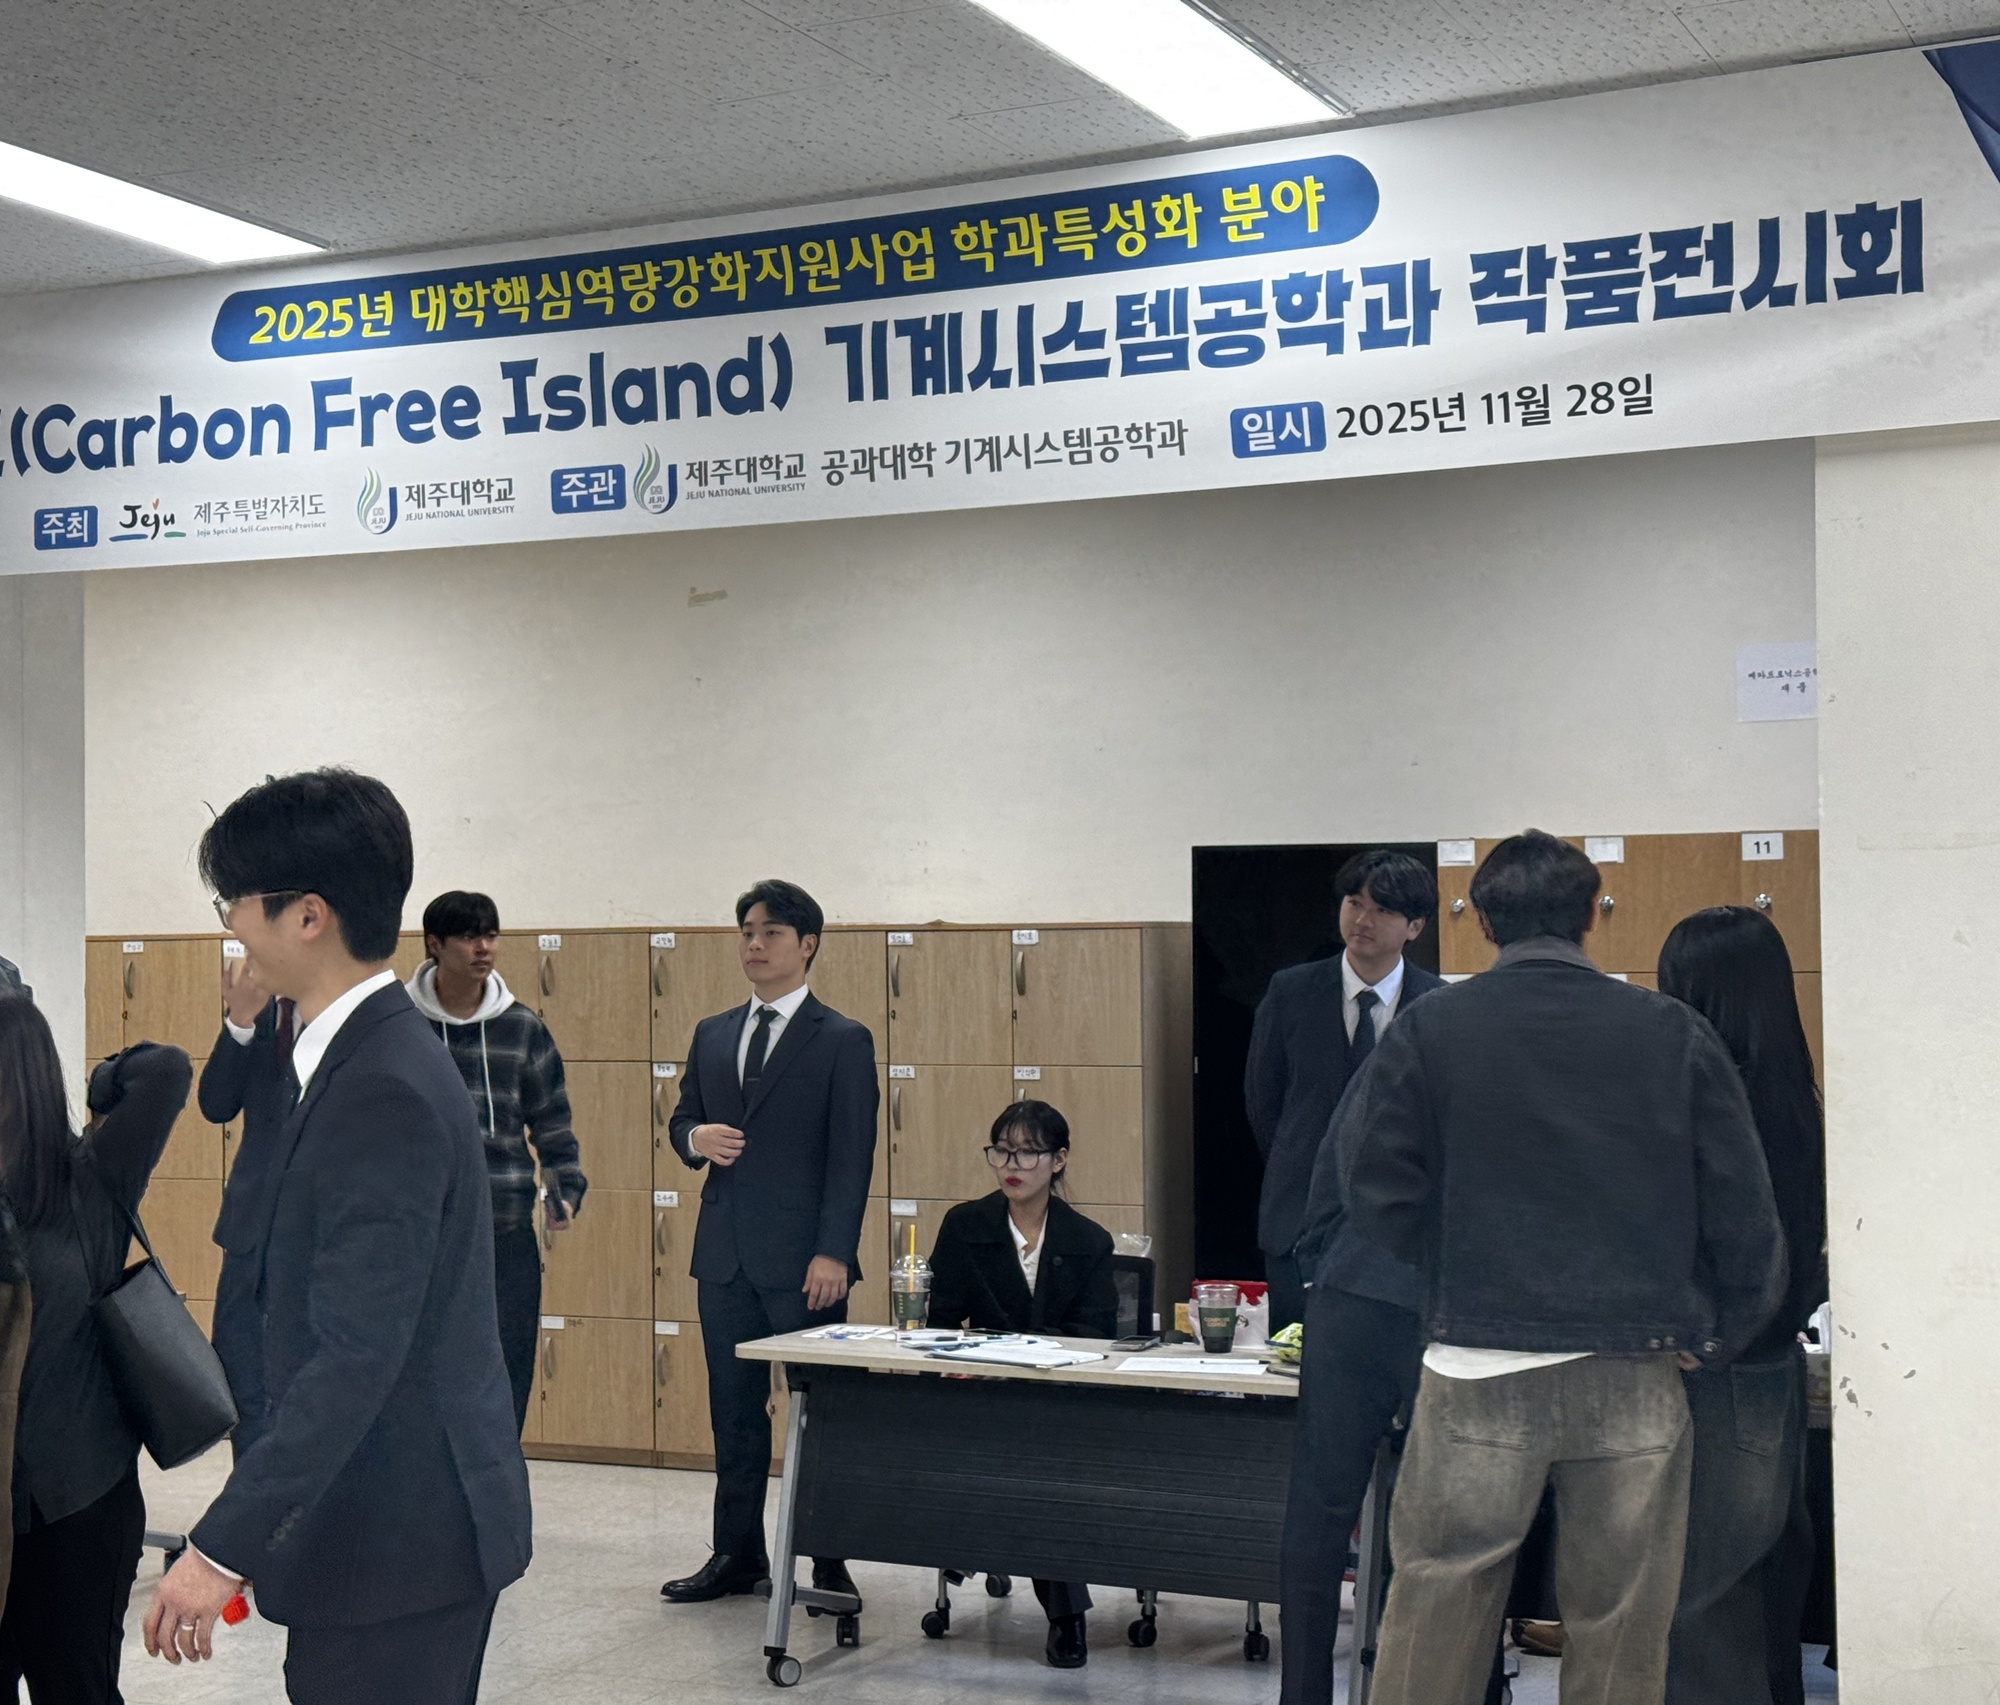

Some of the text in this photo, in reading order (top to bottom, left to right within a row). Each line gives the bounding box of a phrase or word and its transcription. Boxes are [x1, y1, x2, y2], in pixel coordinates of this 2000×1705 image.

[251, 176, 1325, 343] 2025년 대학핵심역량강화지원사업 학과특성화 분야
[0, 198, 1924, 478] (Carbon Free Island) 기계시스템공학과 작품전시회
[1336, 373, 1654, 439] 2025년 11월 28일
[1241, 409, 1313, 450] 일시
[685, 419, 1189, 487] 제주대학교 공과대학 기계시스템공학과
[404, 478, 516, 509] 제주대학교
[560, 470, 618, 508] 주관
[686, 482, 806, 500] JEJU NATIONAL UNIVERSITY
[119, 505, 176, 540] Jeju
[194, 494, 326, 524] 제주특별자치도
[405, 505, 515, 521] JEJU NATIONAL UNIVERSITY
[41, 510, 89, 545] 주최
[212, 525, 239, 536] Special
[295, 520, 327, 530] Province
[1753, 840, 1771, 855] 11
